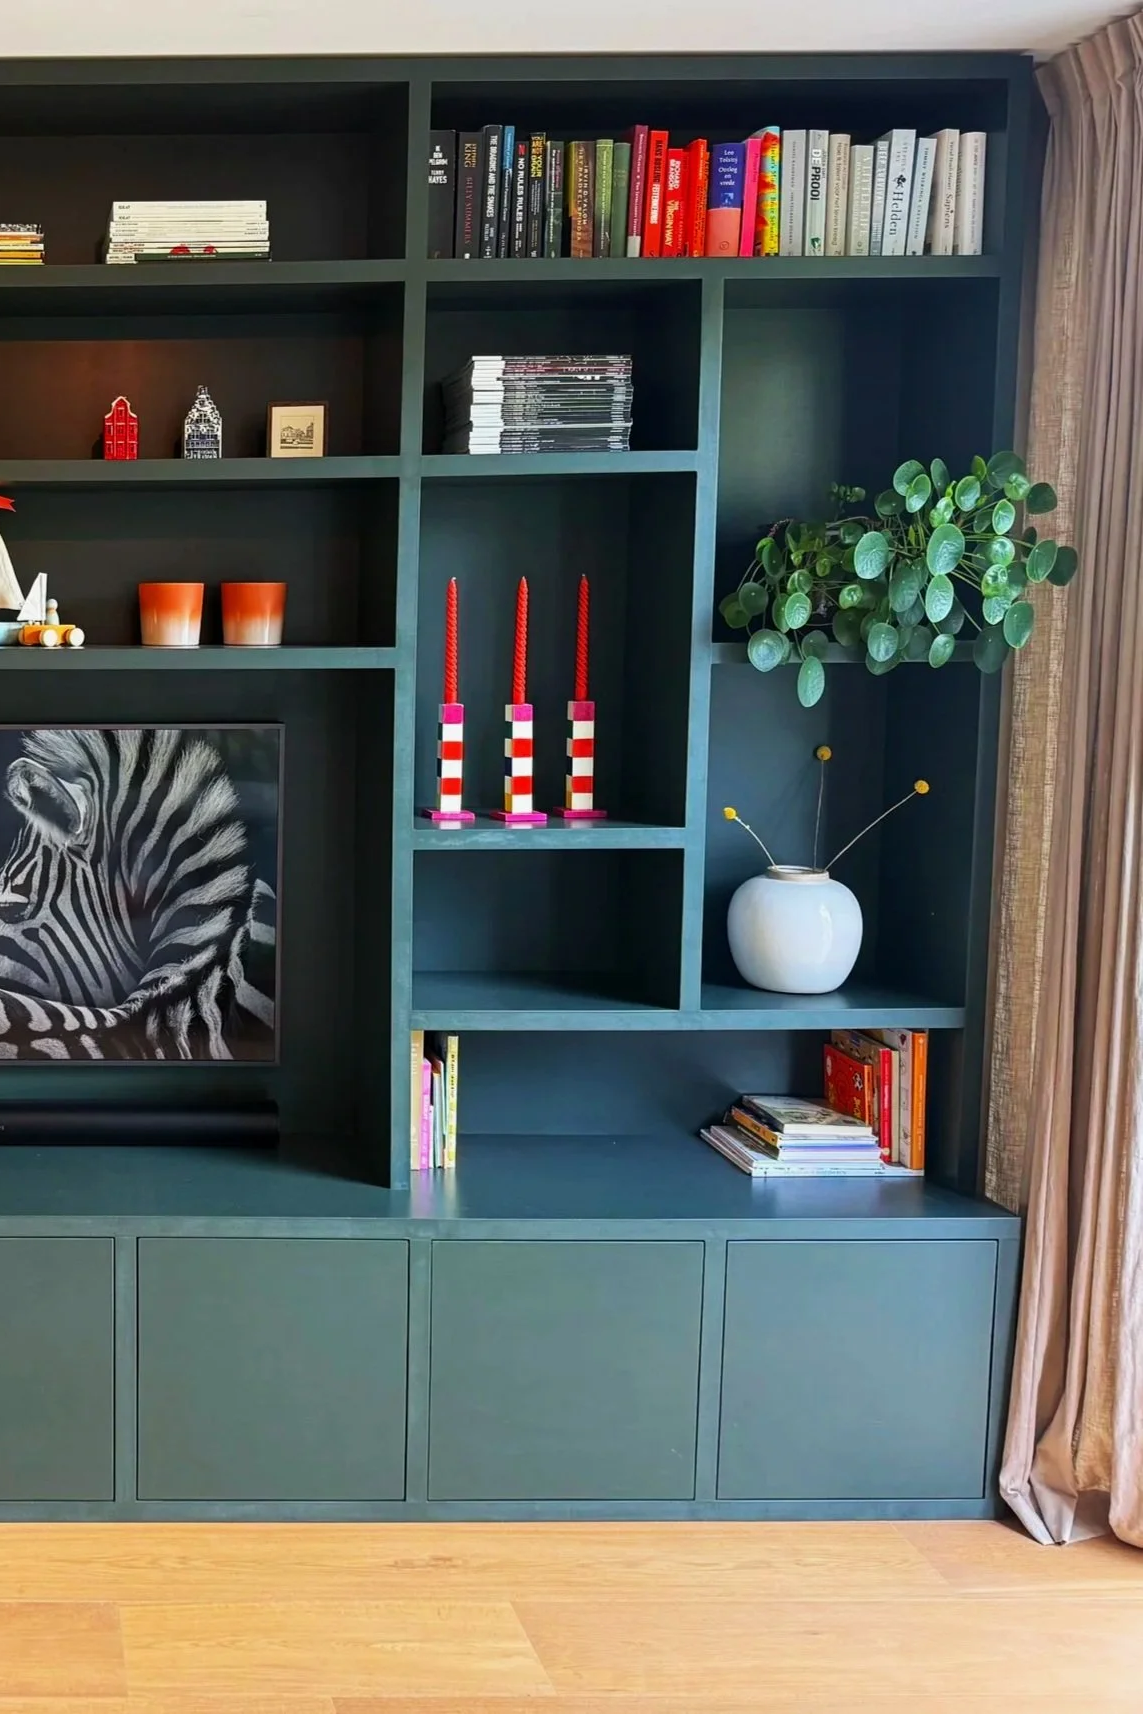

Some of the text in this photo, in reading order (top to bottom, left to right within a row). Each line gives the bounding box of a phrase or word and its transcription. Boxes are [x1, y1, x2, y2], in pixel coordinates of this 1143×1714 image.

[464, 143, 472, 168] KING
[655, 140, 663, 157] HANS
[486, 135, 498, 218] THE DRAGONS AND THE SNAKES
[517, 157, 525, 169] NO
[653, 157, 663, 183] ROSLING
[668, 159, 676, 190] BRANSON
[673, 160, 681, 189] RICHARD
[810, 149, 822, 201] DE PROOI
[428, 175, 448, 184] HAYES
[464, 177, 473, 199] BILLY
[517, 170, 525, 196] RULES
[861, 166, 871, 208] LITTLE
[516, 196, 525, 222] RULES
[889, 191, 904, 236] Helden
[944, 193, 954, 229] Sapiens
[463, 202, 473, 244] SUMMERS
[664, 200, 675, 247] VIRGIN WAY
[859, 211, 869, 236] LIFE
